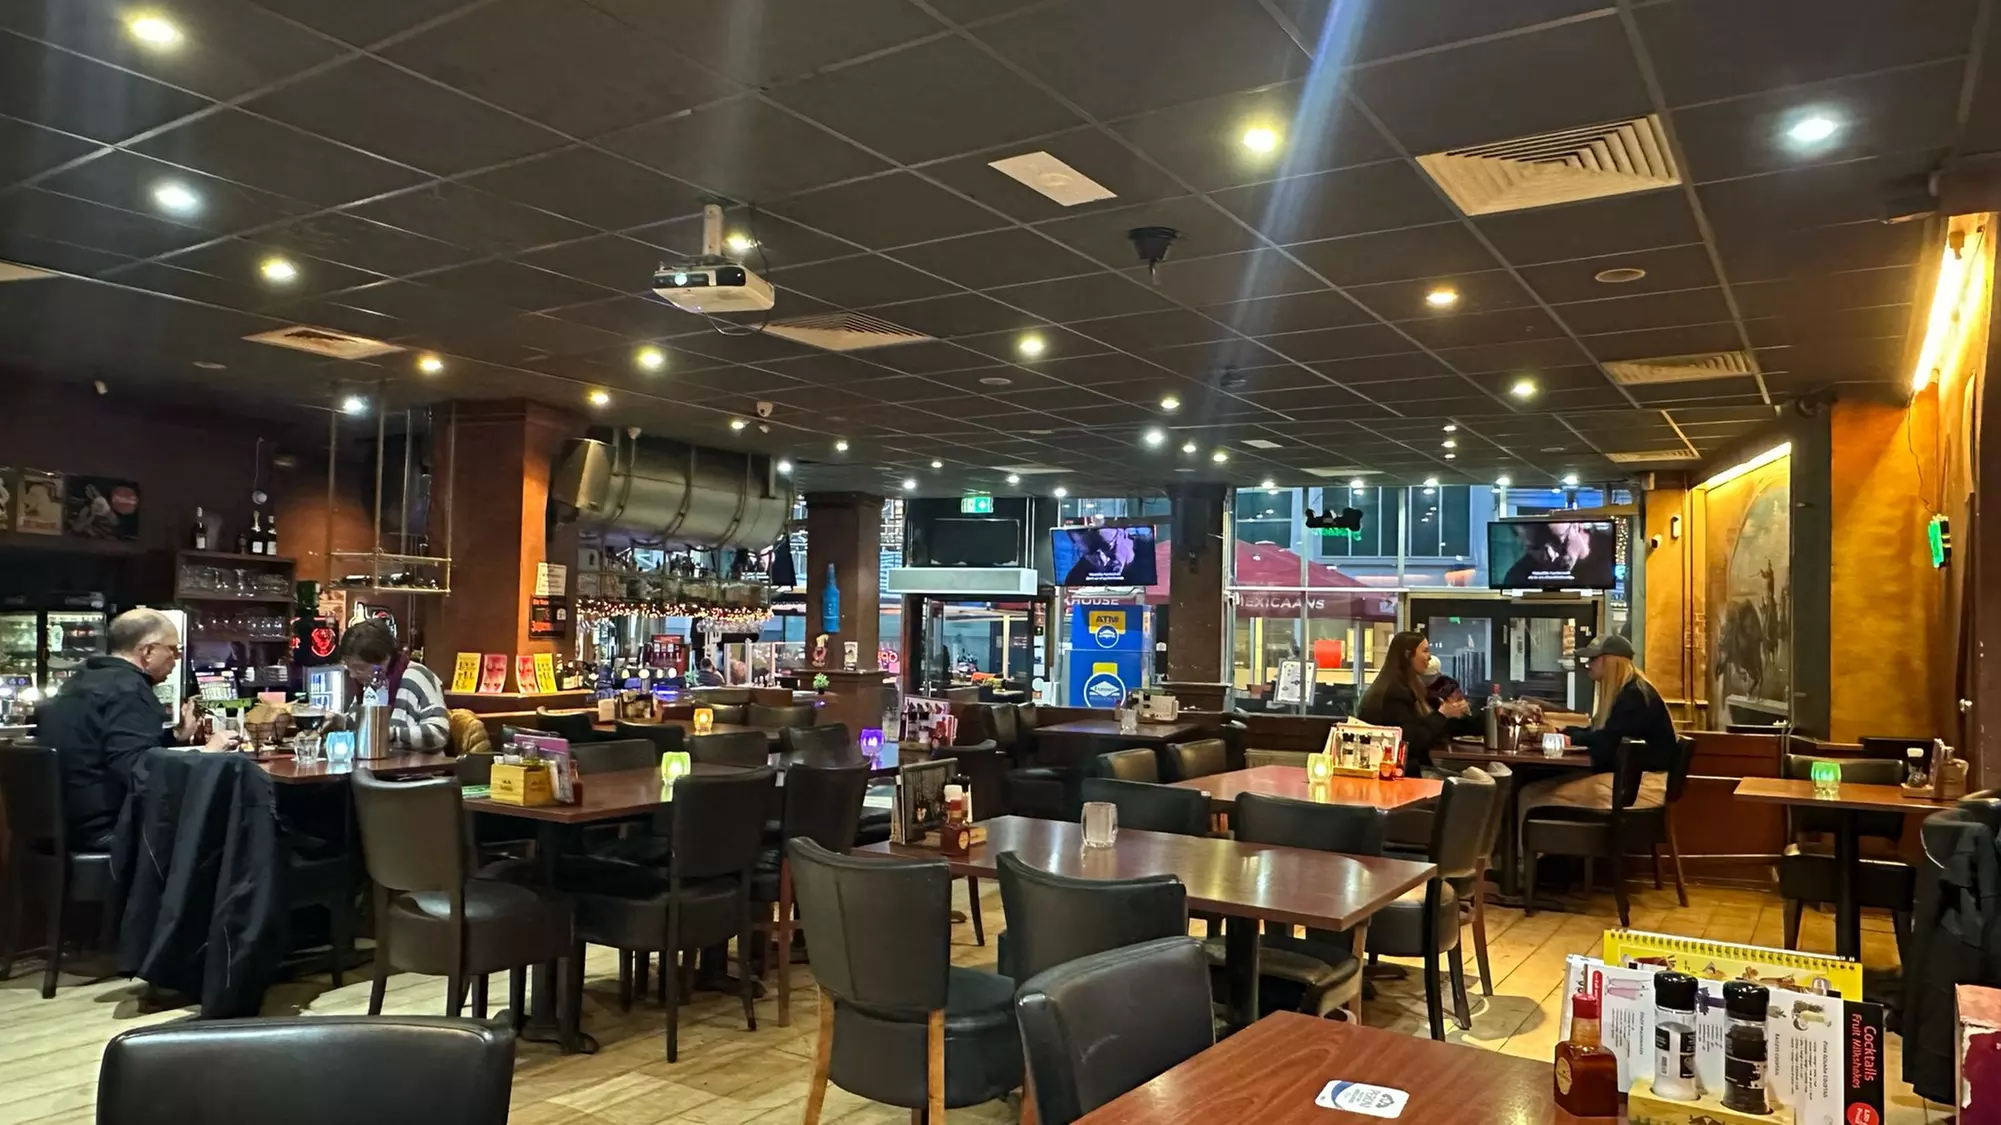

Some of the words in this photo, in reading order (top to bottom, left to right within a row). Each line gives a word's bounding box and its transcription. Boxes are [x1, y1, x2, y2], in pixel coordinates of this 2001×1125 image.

[1096, 615, 1120, 623] ATM
[1852, 1013, 1863, 1036] Fruit
[1852, 1038, 1863, 1089] Milkshakes
[1864, 1025, 1878, 1082] Cocktails
